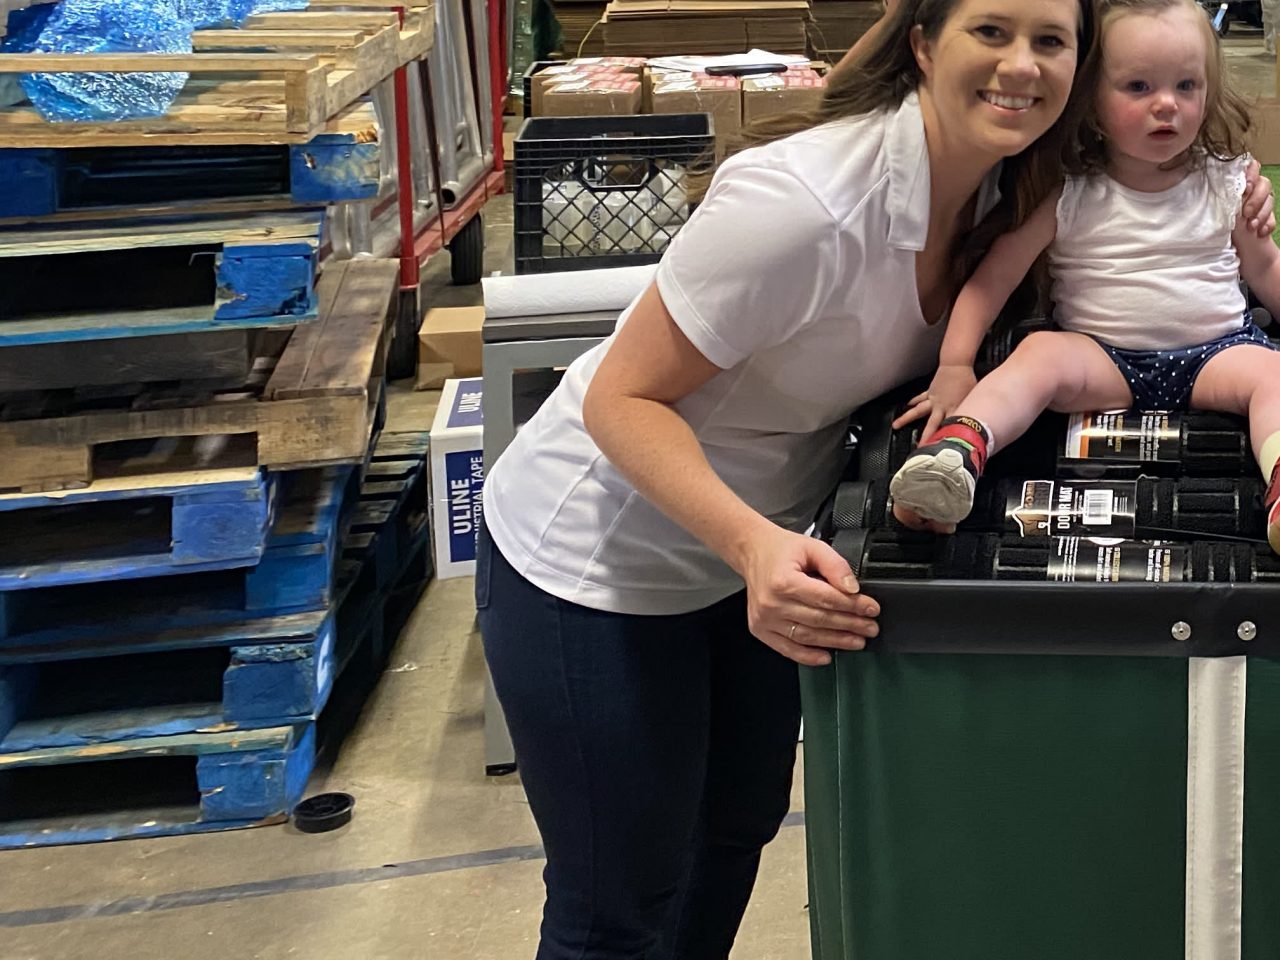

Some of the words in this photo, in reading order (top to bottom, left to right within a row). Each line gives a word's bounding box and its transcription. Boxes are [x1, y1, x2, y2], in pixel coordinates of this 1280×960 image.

[457, 392, 484, 413] ULINE
[471, 456, 483, 485] TAPE
[451, 478, 472, 535] ULINE
[1059, 486, 1073, 503] MAT
